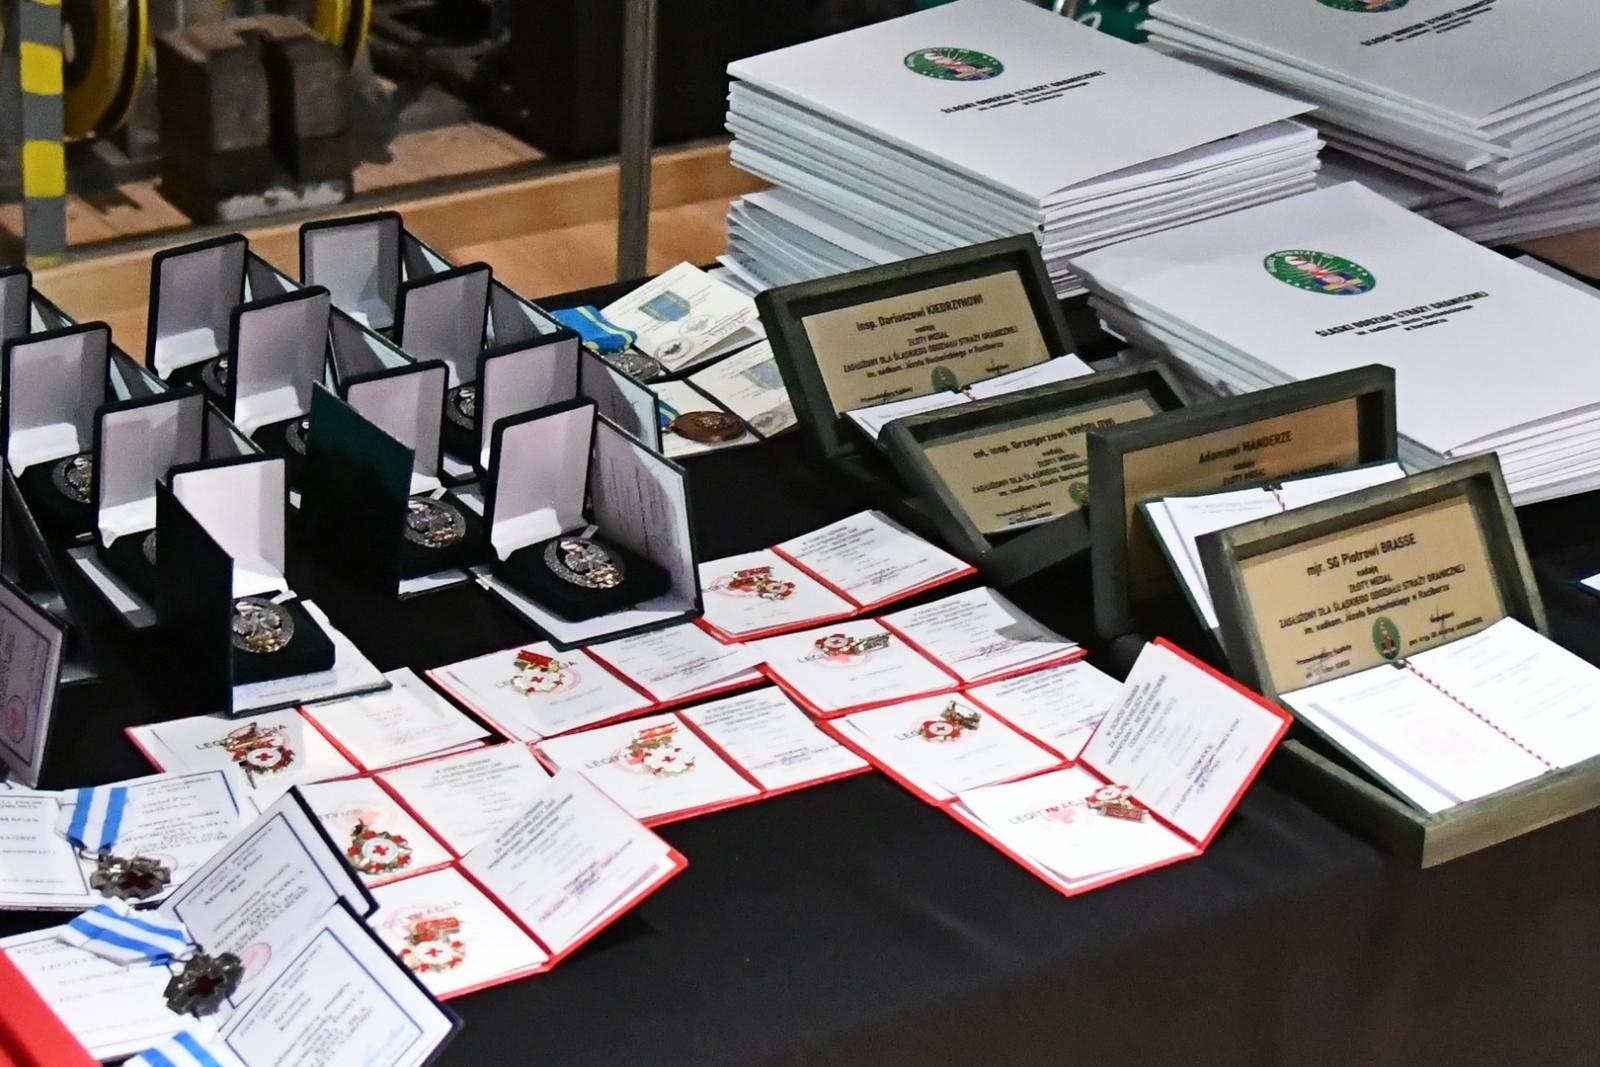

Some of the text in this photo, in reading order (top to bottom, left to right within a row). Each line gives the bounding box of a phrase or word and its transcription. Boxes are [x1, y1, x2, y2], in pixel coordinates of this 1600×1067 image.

[856, 321, 878, 332] insp.
[878, 307, 926, 326] Dariuszowi
[1242, 430, 1292, 451] MANDERZE
[1326, 556, 1340, 570] SG
[1340, 544, 1379, 565] Piotrowi
[1380, 533, 1416, 553] BRASSE
